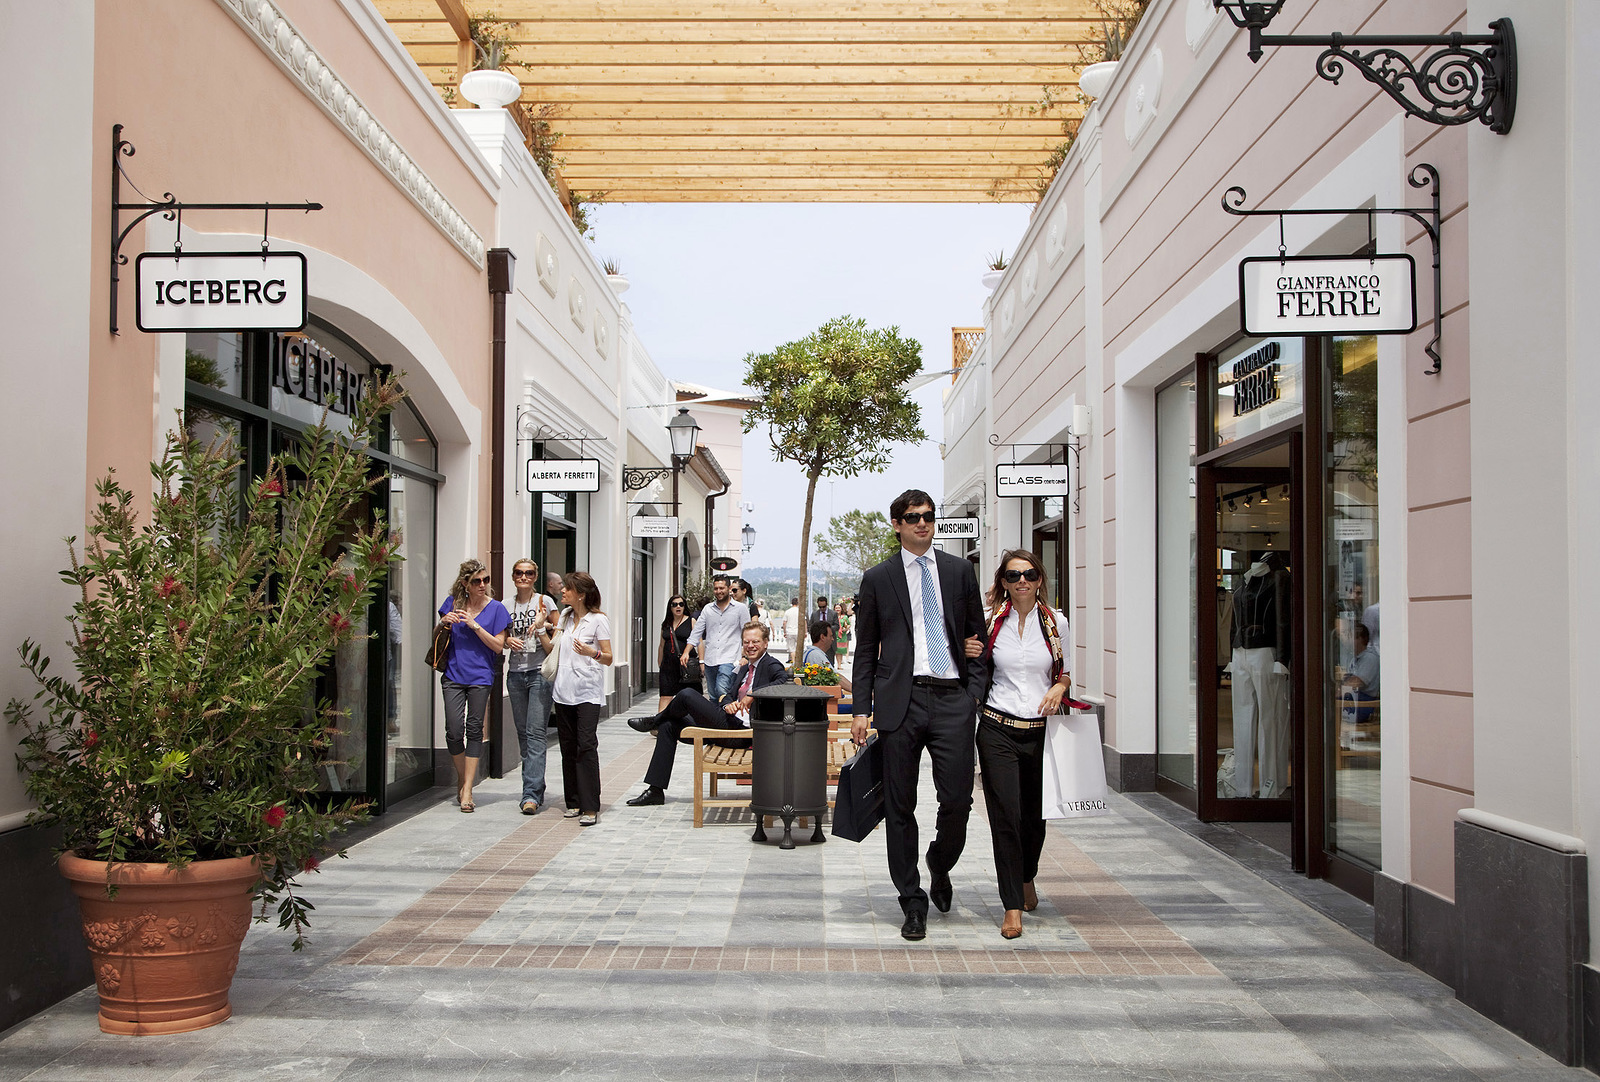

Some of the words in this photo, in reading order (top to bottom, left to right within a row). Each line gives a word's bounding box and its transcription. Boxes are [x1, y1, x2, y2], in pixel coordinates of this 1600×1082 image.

[155, 279, 287, 305] ICEBERG
[1276, 275, 1380, 290] GIANFRANCO
[1276, 290, 1381, 317] FERRE
[1233, 363, 1280, 417] FERRE
[999, 477, 1043, 485] CLASS
[937, 522, 974, 534] MOSCHINO
